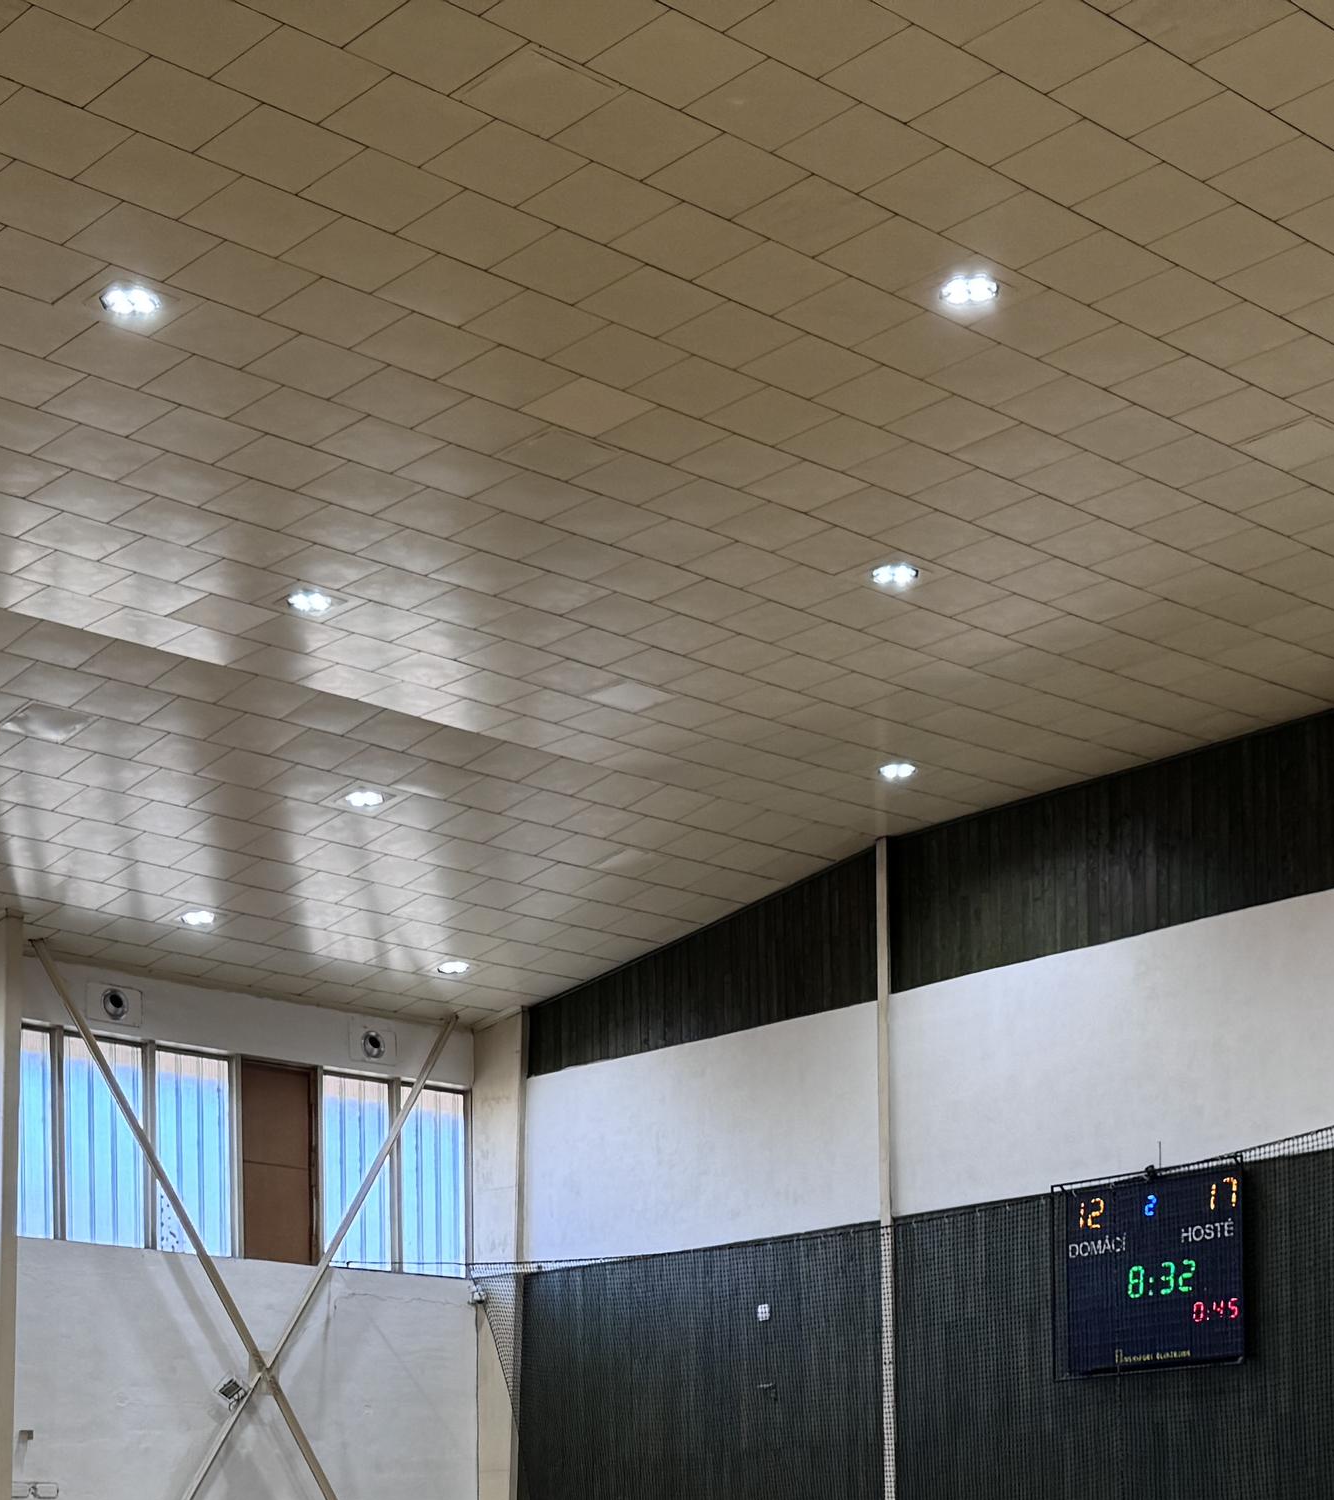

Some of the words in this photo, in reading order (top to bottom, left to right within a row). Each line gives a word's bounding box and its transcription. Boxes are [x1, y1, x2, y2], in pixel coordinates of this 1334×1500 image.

[1144, 1195, 1157, 1216] 2
[1210, 1177, 1238, 1210] 17
[1079, 1198, 1104, 1229] 12
[1181, 1218, 1235, 1243] HOSTÉ
[1069, 1232, 1127, 1259] DOMÁCÍ
[1128, 1259, 1196, 1298] 8:32
[1193, 1298, 1239, 1322] 0:45
